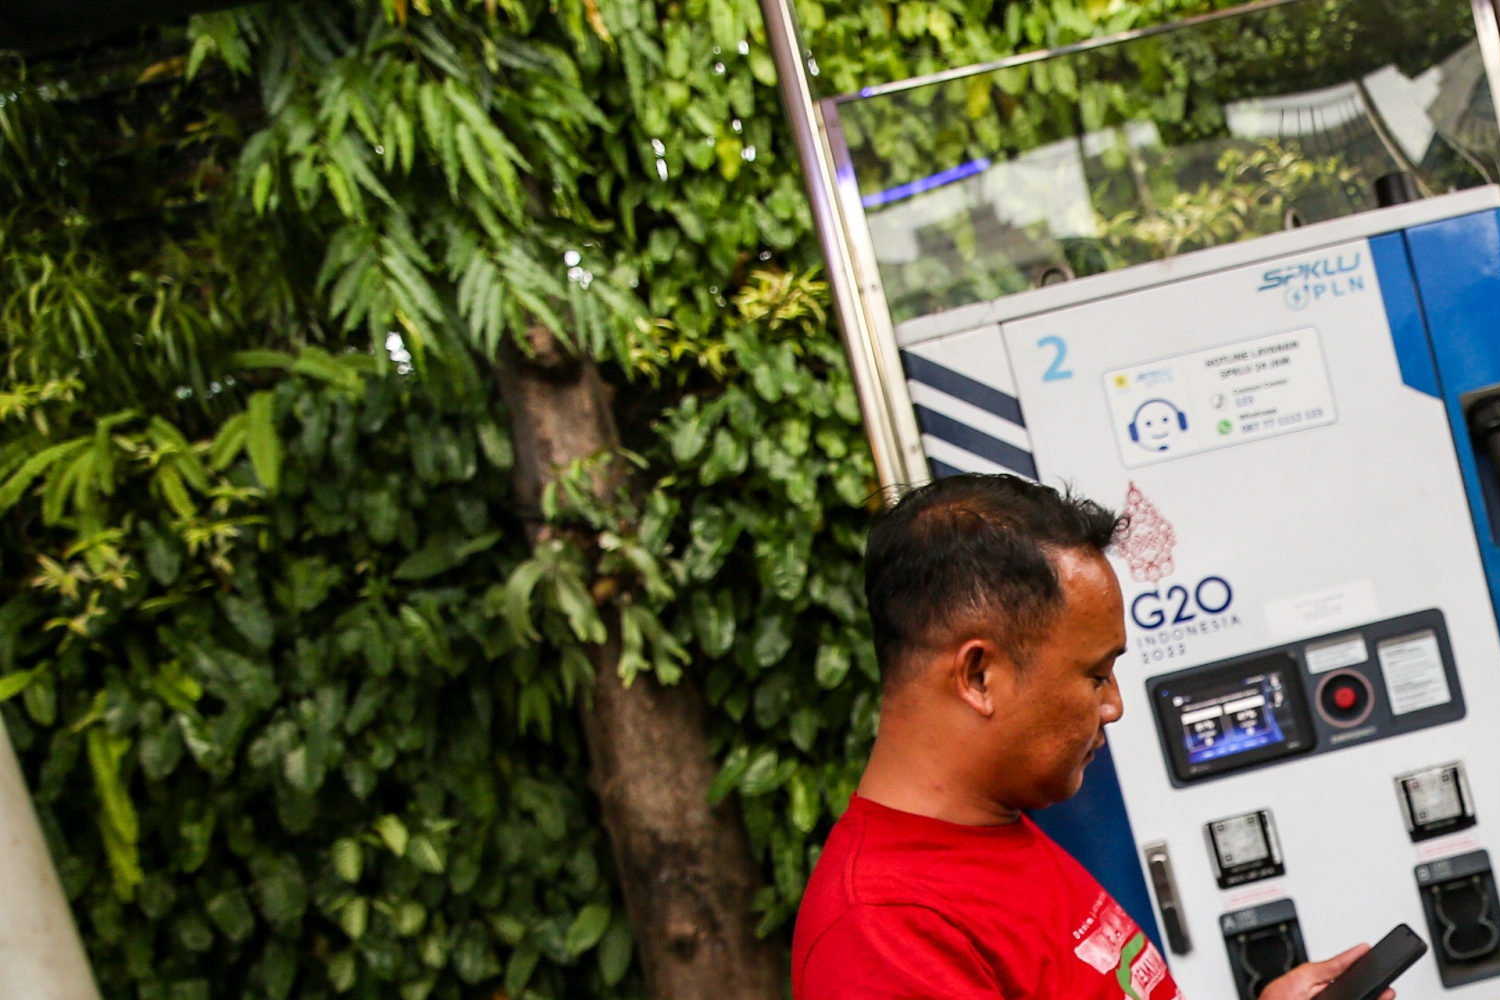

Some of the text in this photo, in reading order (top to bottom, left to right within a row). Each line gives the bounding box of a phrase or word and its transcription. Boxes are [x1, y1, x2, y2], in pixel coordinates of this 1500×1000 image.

[1258, 253, 1361, 292] SPKLU
[1313, 275, 1364, 299] PLN
[1036, 335, 1073, 382] 2
[1131, 576, 1232, 630] G20
[1137, 614, 1241, 650] INDONESIA
[1143, 643, 1187, 665] 2022
